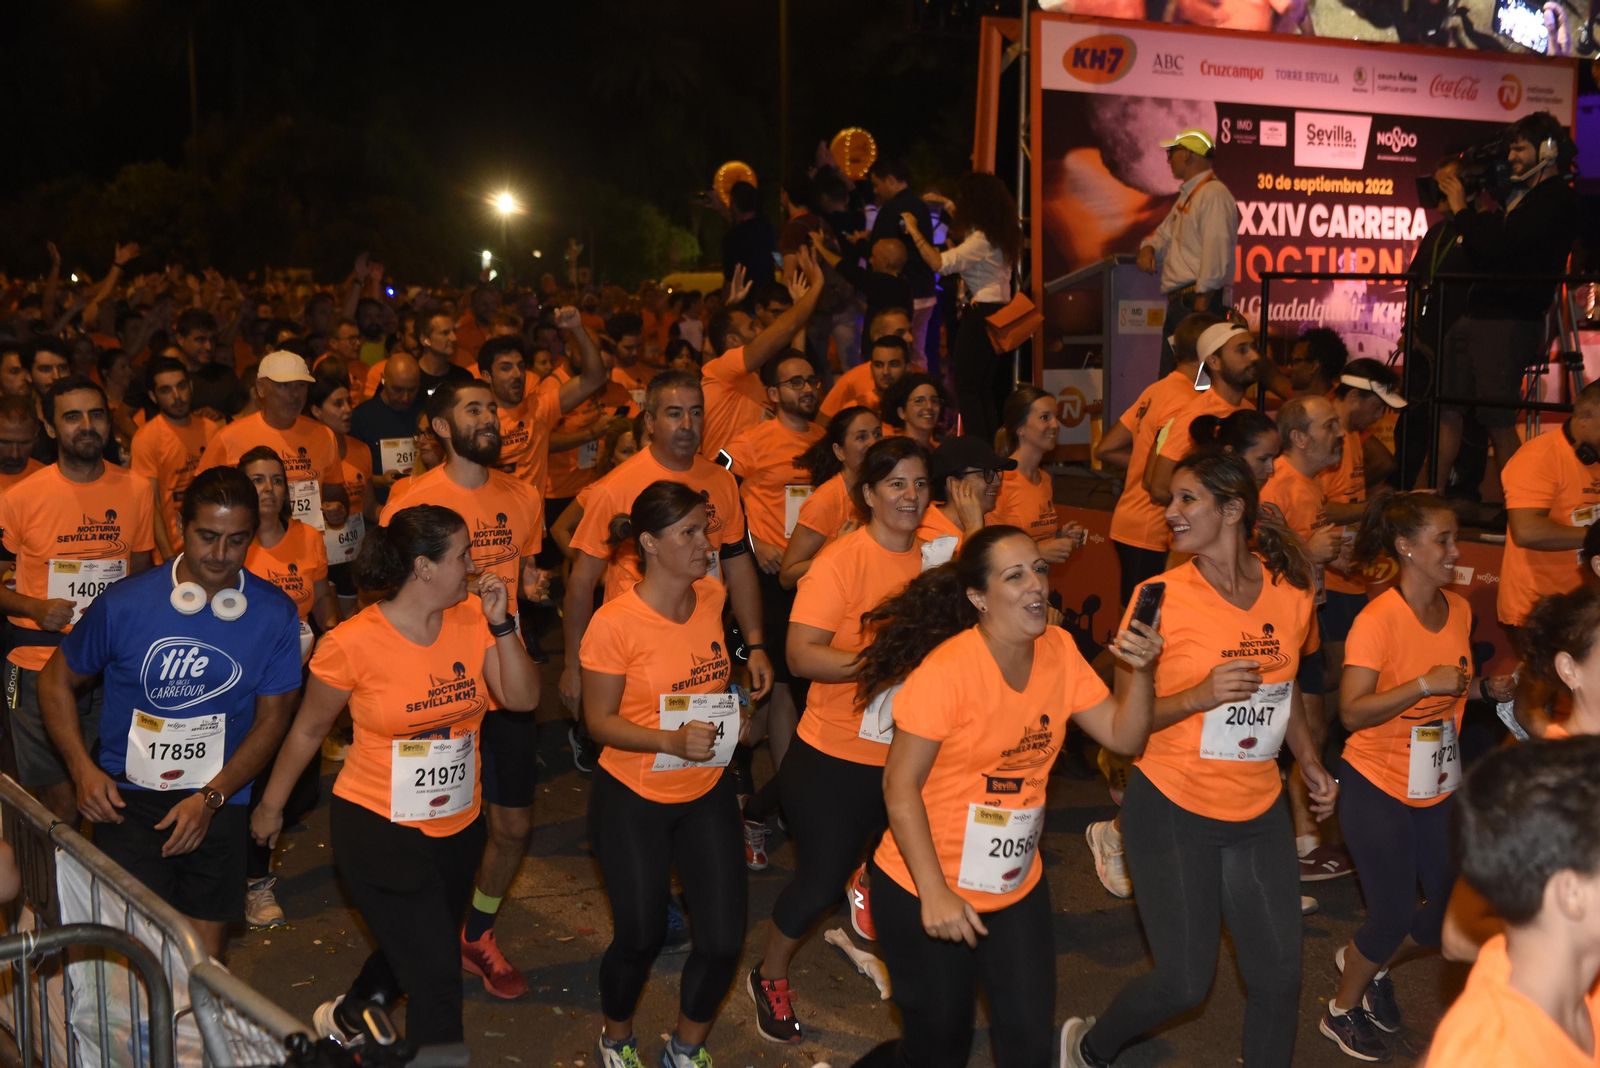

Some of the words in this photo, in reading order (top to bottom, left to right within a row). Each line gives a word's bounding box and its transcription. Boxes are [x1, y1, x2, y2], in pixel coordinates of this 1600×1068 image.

[1153, 53, 1184, 70] ABC
[1200, 60, 1264, 81] Cruzcampo
[1275, 69, 1302, 81] TORRE
[1305, 71, 1339, 84] SEVILLA
[1236, 119, 1253, 131] IMD
[1257, 172, 1274, 190] 30
[1275, 174, 1291, 190] de
[1293, 175, 1364, 196] septiembre
[1365, 178, 1394, 195] 2022
[1309, 203, 1429, 240] CARRERA
[1235, 244, 1418, 285] OCTURN
[1131, 308, 1143, 316] IMD
[77, 525, 121, 533] NOCTURNA
[338, 529, 358, 544] 6430
[473, 529, 513, 539] NOCTURNA
[57, 533, 97, 543] SEVILLA
[470, 538, 491, 548] VILLA
[1239, 639, 1280, 648] NOCTURNA
[1221, 648, 1260, 658] SEVILLA
[691, 658, 729, 677] NOCTURNA
[150, 684, 206, 699] CARREFOUR
[428, 678, 476, 697] NOCTURNA
[671, 674, 711, 692] SEVILLA
[406, 695, 454, 713] SEVILLA
[1225, 706, 1275, 726] 20047
[148, 742, 206, 761] 17858
[414, 762, 466, 787] 21973
